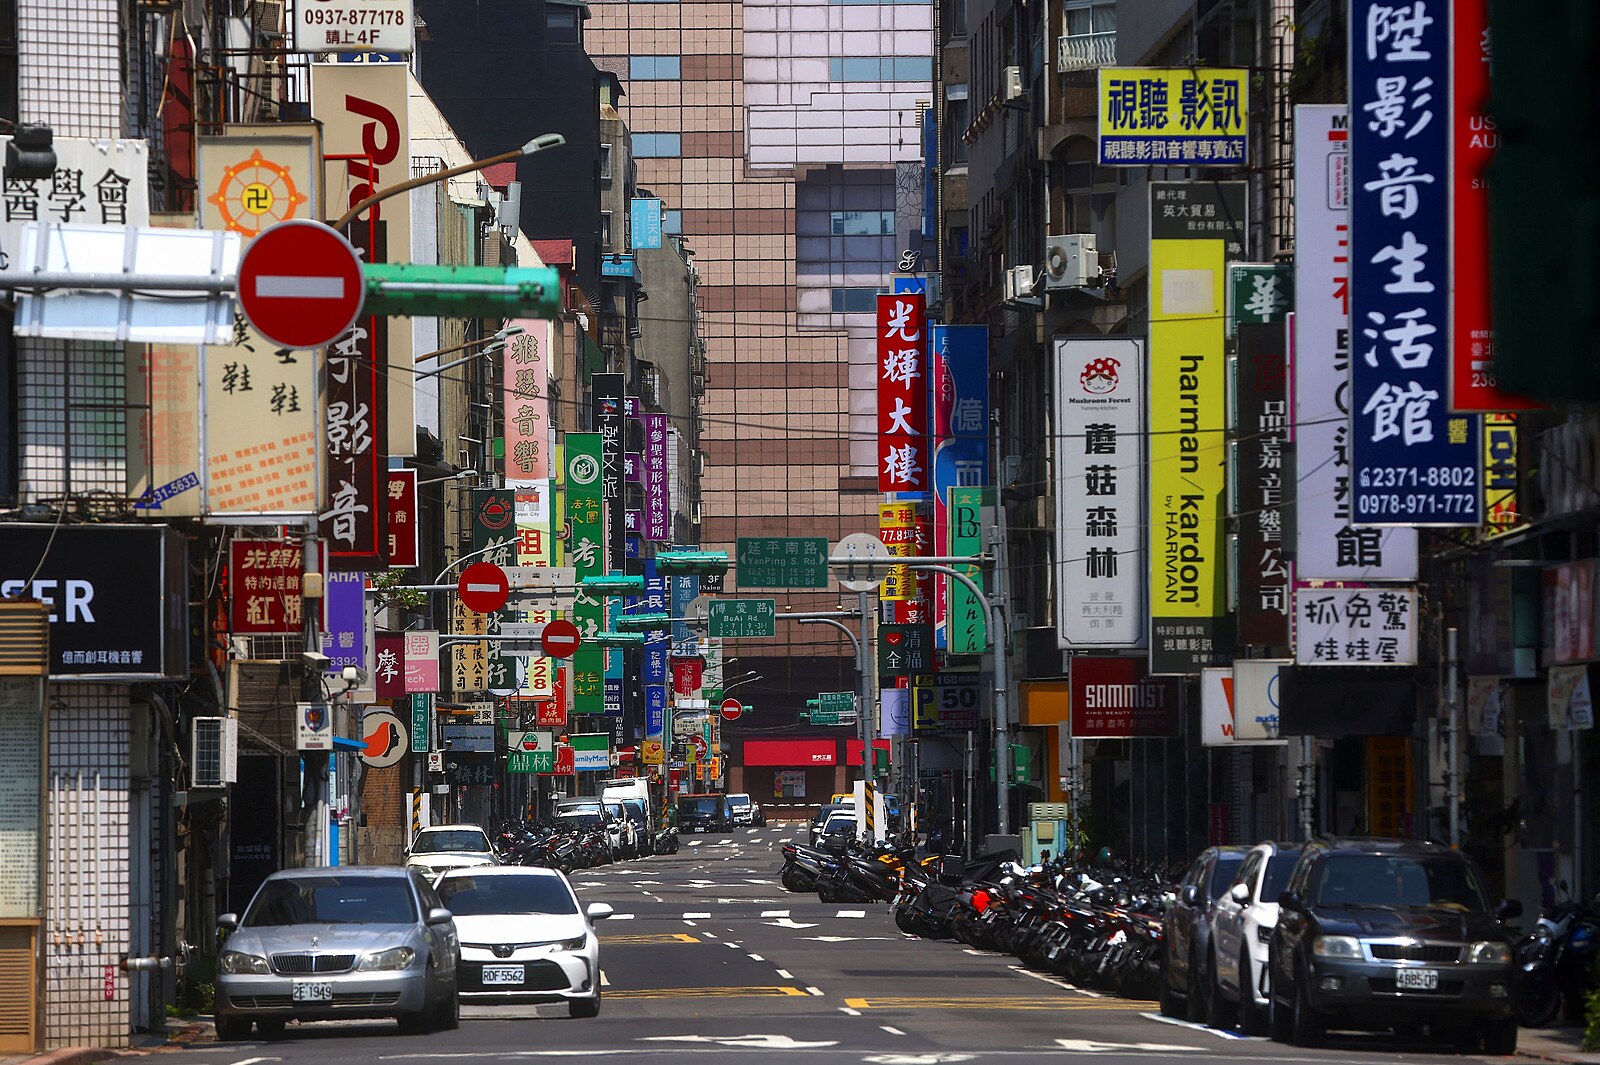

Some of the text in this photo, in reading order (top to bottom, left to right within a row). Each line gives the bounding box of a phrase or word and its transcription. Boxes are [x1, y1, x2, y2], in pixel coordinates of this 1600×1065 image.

[305, 9, 404, 25] 0937-877178
[325, 29, 381, 44] 請上4F
[1104, 140, 1243, 160] 視聽影訊音響專賣店
[1156, 190, 1187, 200] 總代理
[1163, 204, 1216, 217] 英大貿易
[1188, 220, 1244, 230] 股份有限公司
[1363, 2, 1438, 446] 陞影音生活館
[941, 336, 952, 403] EARTRON
[883, 300, 923, 485] 光輝大樓
[510, 334, 541, 473] 雅瑟音響
[1372, 467, 1475, 487] 2371-8802
[1084, 423, 1118, 579] 蘑菇森林
[1358, 495, 1475, 515] 0978-971-772
[898, 509, 913, 523] 租
[517, 529, 542, 555] 租
[881, 528, 915, 542] 77.8坪
[748, 541, 818, 555] 延平南路
[1166, 496, 1178, 603] by HARMAN
[748, 557, 818, 567] YanPing S. Rd.
[886, 545, 898, 597] 誠不動產
[708, 575, 719, 584] 3F
[647, 577, 664, 642] 三民考
[715, 602, 767, 614] 博愛路
[1156, 626, 1204, 635] 特約經銷商
[1164, 639, 1213, 651] 視聽影訊
[1313, 637, 1399, 663] 娃娃屋
[62, 650, 143, 664] 億而創耳機音響
[917, 689, 935, 717] P
[513, 754, 550, 771] 鼎林
[574, 755, 608, 764] amilyMart
